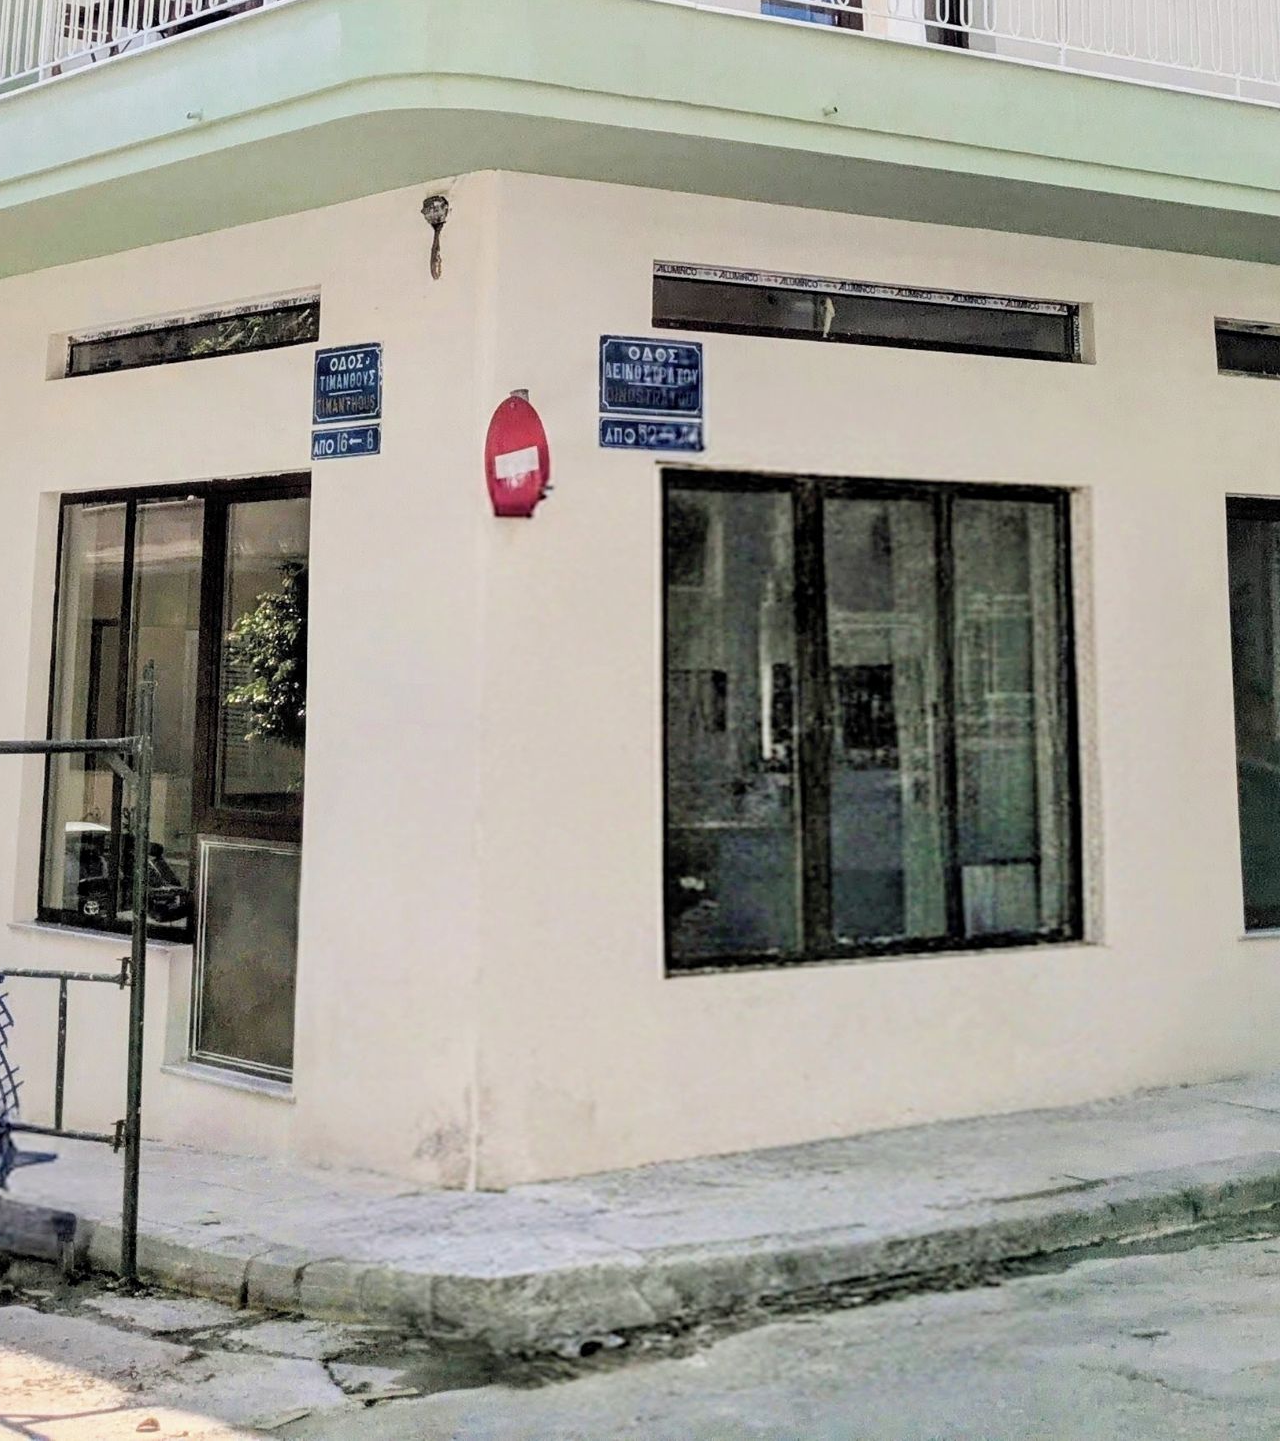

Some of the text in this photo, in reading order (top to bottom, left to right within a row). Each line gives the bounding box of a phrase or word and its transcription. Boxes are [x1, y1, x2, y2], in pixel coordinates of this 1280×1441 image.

[329, 353, 364, 371] ΟΔΟΣ
[628, 346, 678, 364] ΟΔΟΣ
[319, 369, 376, 392] ΤΙΜΑΝΘΟΥΣ
[606, 362, 698, 385] ΔΕΙΝΟΣΤΡΑΤΟΥ
[313, 429, 374, 455] ΑΠΟ 16 8
[604, 427, 636, 444] ΑΠΟ
[638, 423, 657, 445] 52
